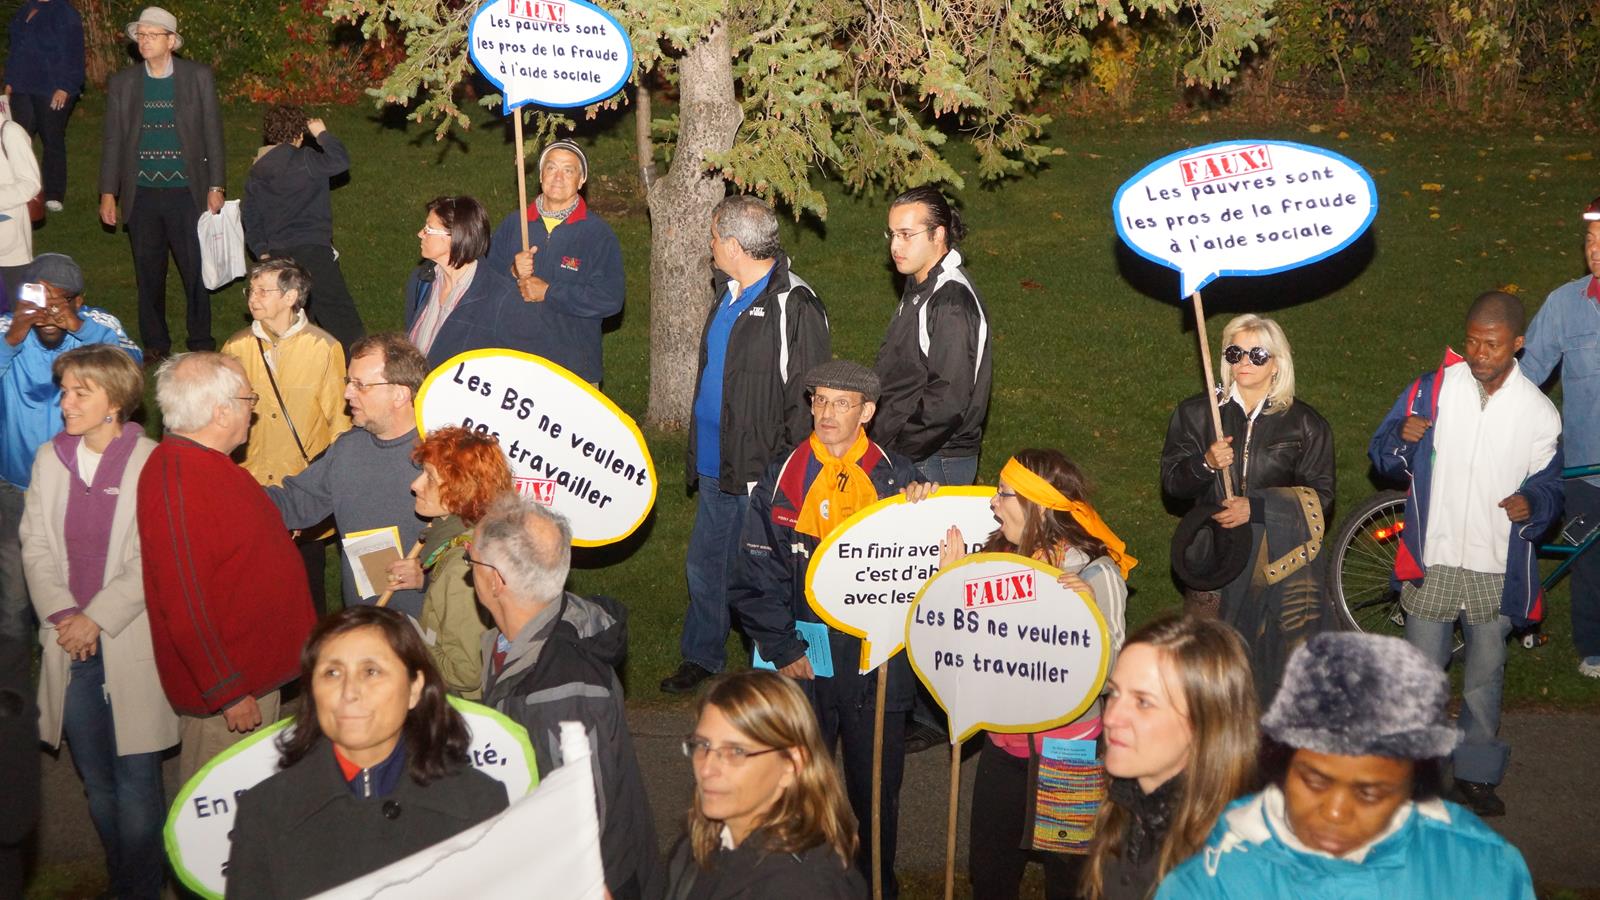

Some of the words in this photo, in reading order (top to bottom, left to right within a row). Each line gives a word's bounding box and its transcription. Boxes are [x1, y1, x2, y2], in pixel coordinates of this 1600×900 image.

[490, 14, 511, 28] Les
[516, 21, 570, 33] pauvres
[576, 24, 606, 36] sont
[511, 0, 563, 22] FAUX!
[477, 37, 495, 50] les
[499, 42, 526, 55] pros
[532, 43, 548, 56] de
[553, 44, 566, 57] la
[571, 45, 619, 61] fraude
[500, 61, 507, 74] à
[512, 62, 548, 79] l'aide
[553, 68, 601, 83] sociale
[1182, 148, 1269, 183] FAUX!
[1145, 185, 1182, 202] Les
[1191, 175, 1276, 201] pauvres
[1286, 166, 1335, 184] sont
[1127, 216, 1157, 231] les
[1166, 213, 1210, 230] pros
[1220, 207, 1244, 223] de
[1252, 203, 1272, 218] la
[1282, 192, 1357, 214] fraude
[1170, 239, 1181, 254] à
[1190, 233, 1248, 253] l'aide
[1256, 222, 1333, 243] sociale
[453, 362, 492, 396] Les
[501, 388, 535, 420] BS
[538, 414, 562, 438] ne
[571, 433, 648, 486] veulent
[509, 440, 612, 509] travailler
[515, 481, 552, 501] UX!
[838, 543, 862, 559] En
[868, 543, 903, 559] finir
[908, 544, 947, 557] ave
[855, 566, 897, 582] c'est
[844, 592, 889, 605] avec
[891, 590, 916, 604] les
[965, 574, 1034, 607] FAUX!
[915, 604, 945, 627] Les
[954, 608, 980, 633] BS
[987, 619, 1008, 638] ne
[1017, 624, 1091, 648] veulent
[935, 650, 964, 670] pas
[973, 653, 1069, 683] travailler
[193, 796, 229, 818] En
